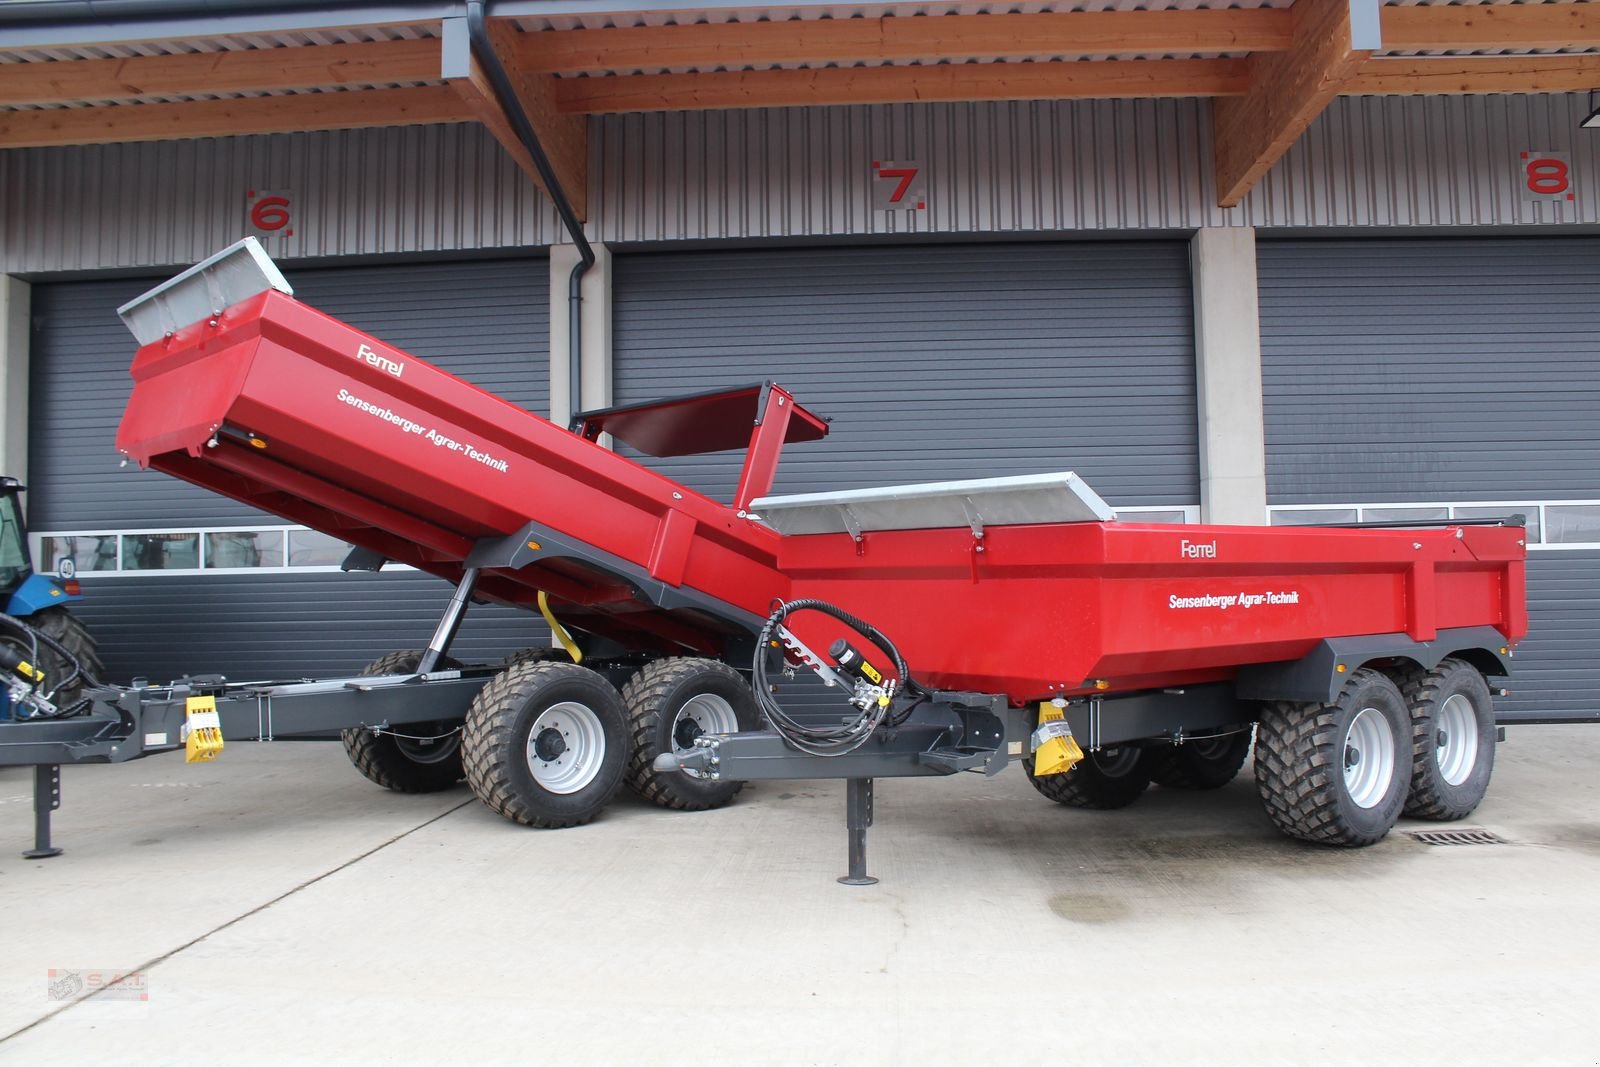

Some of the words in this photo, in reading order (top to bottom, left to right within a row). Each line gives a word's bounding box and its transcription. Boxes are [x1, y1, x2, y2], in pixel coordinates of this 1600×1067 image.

[879, 168, 918, 202] 7
[1526, 159, 1569, 194] 8
[252, 196, 289, 231] 6
[356, 344, 404, 378] Ferrel
[336, 388, 426, 435] Sensenberger
[425, 429, 509, 473] Agrar-Technik
[1181, 539, 1217, 558] Ferrel
[1169, 593, 1237, 609] Sensenberger
[1238, 591, 1299, 608] Agrar-Technik
